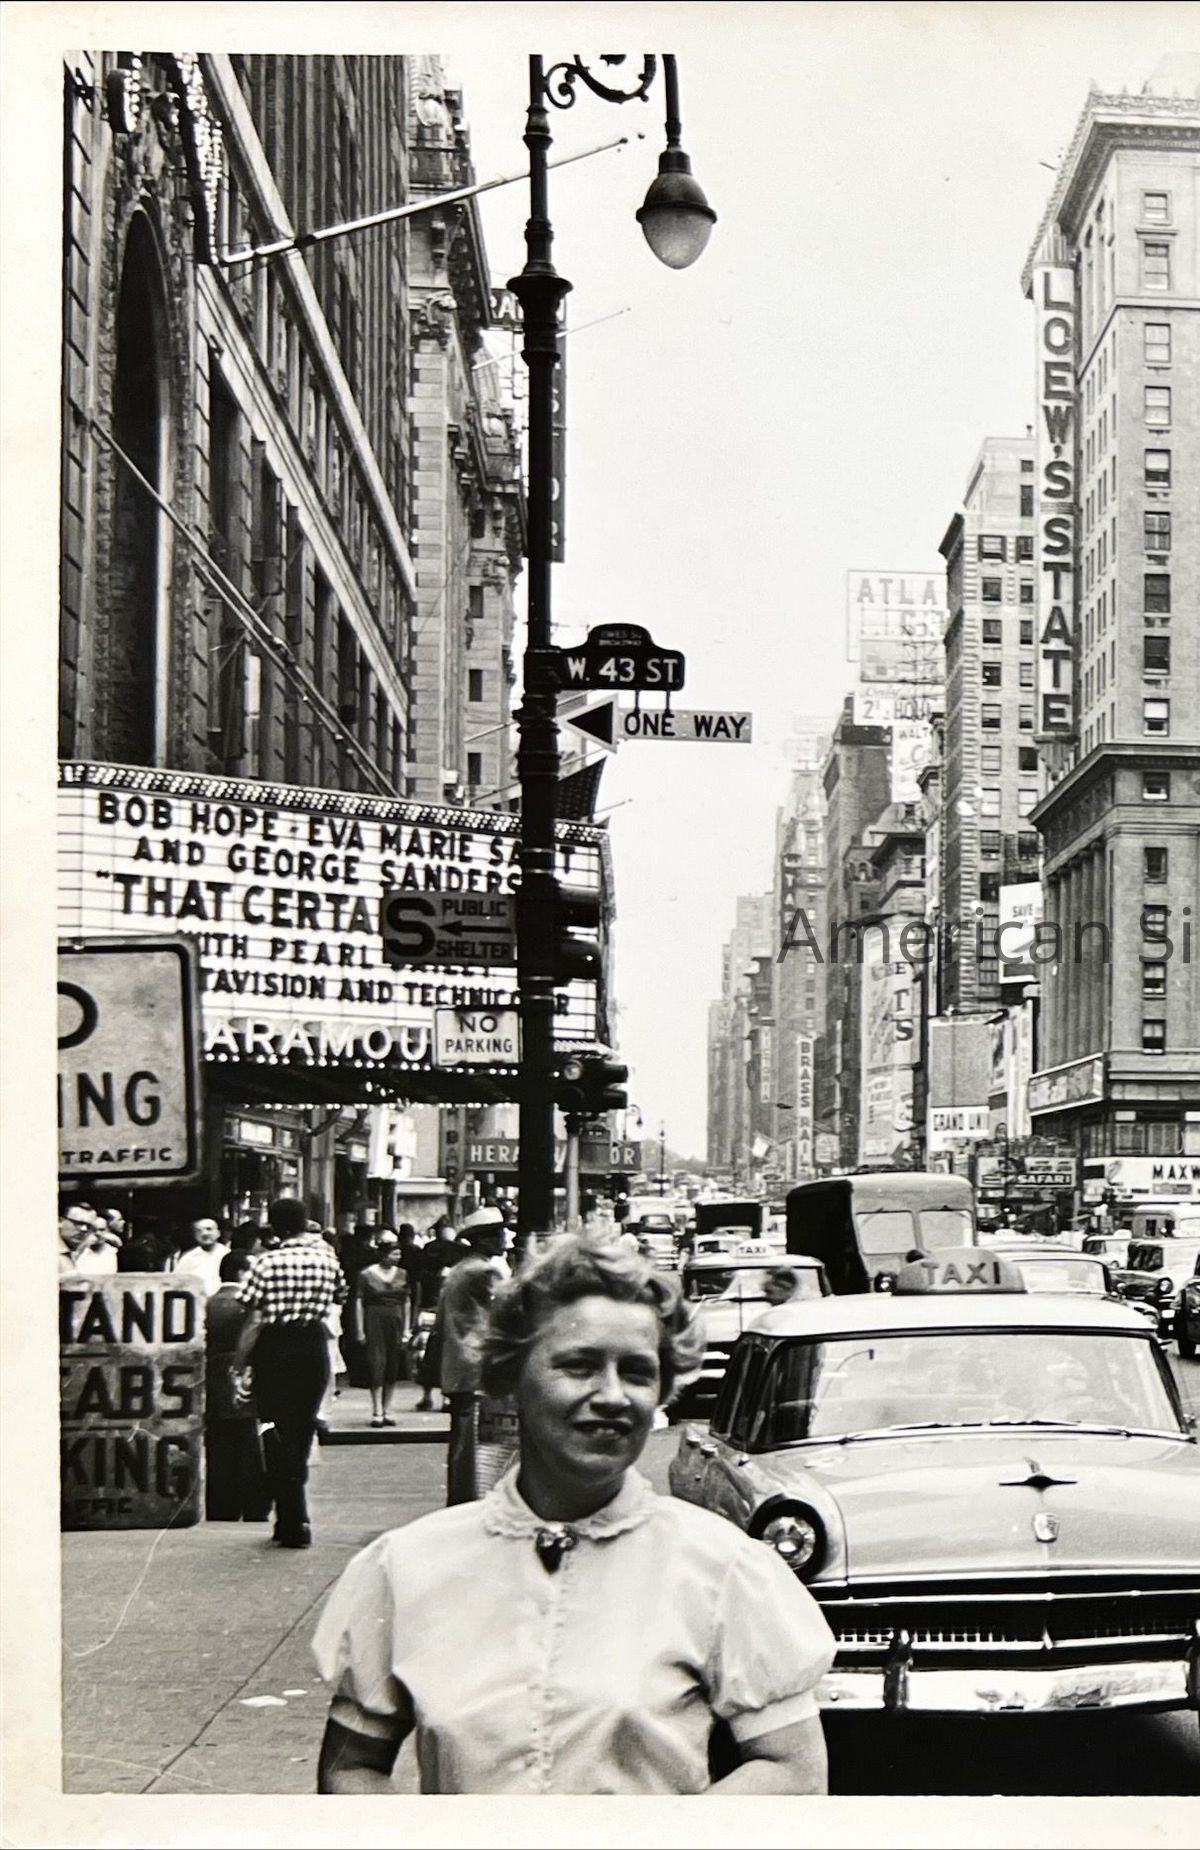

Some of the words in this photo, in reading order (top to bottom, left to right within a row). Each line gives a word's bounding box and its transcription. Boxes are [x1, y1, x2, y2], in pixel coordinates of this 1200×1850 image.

[1043, 272, 1074, 499] LOEW'S
[1042, 518, 1073, 732] STATE
[599, 657, 635, 683] 43
[624, 712, 676, 737] ONE
[694, 714, 747, 738] WAY
[98, 792, 173, 831] BOB
[190, 801, 279, 842] HOPE
[308, 816, 364, 851] EVA
[379, 825, 474, 863] MARIE
[489, 833, 576, 876] SAT
[133, 835, 206, 867] AND
[228, 842, 360, 886] GEORGE
[380, 859, 523, 895] SANDERS
[242, 884, 373, 935] CERTA
[442, 899, 508, 918] PUBLIC
[269, 937, 376, 969] PEARL
[436, 940, 512, 960] SHELTER
[337, 977, 394, 1005] AND
[458, 1015, 499, 1034] NO
[444, 1038, 514, 1054] PARKING
[800, 1041, 812, 1108] BRASS
[61, 1147, 172, 1165] TRAFFIC
[1017, 1174, 1071, 1184] SAFARI
[739, 1246, 766, 1254] TAXI
[920, 1261, 1002, 1286] TAXI
[59, 1290, 196, 1343] TAND
[60, 1364, 195, 1418] ABS
